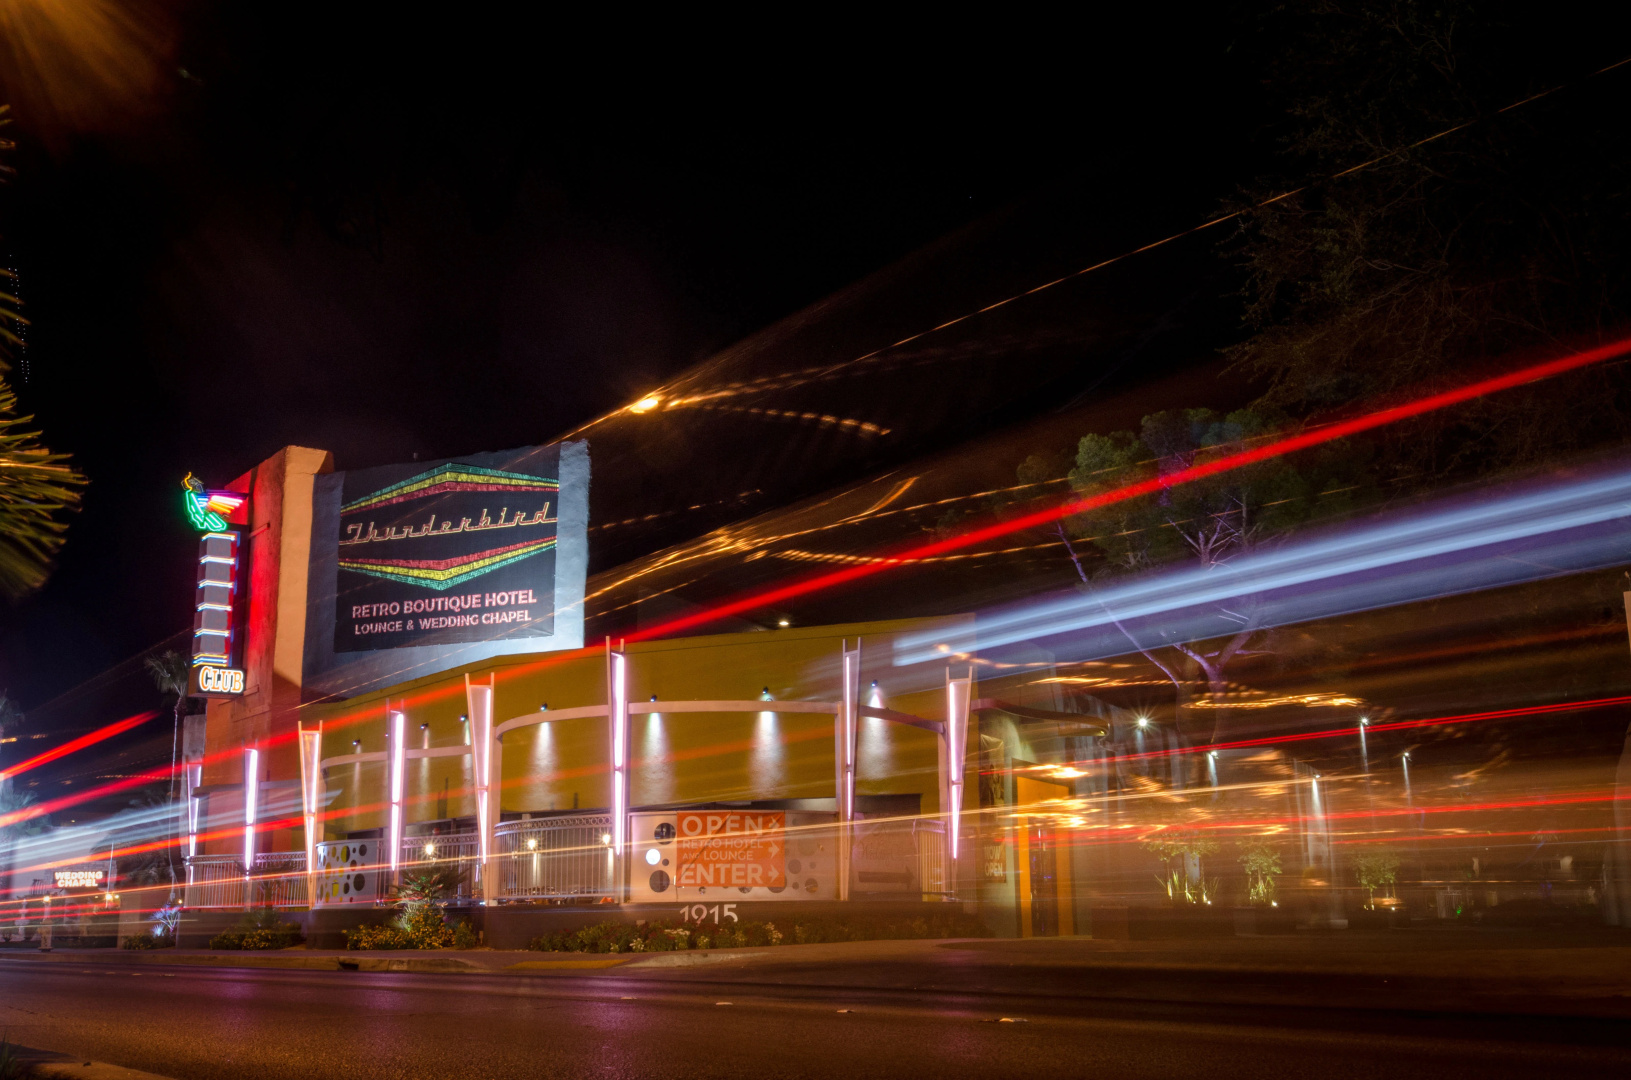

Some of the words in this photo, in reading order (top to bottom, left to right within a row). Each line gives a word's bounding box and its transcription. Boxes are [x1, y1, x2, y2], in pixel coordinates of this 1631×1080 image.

[339, 502, 558, 545] Thunderbird
[352, 601, 400, 619] RETRO
[403, 593, 482, 614] BOUTIQUE
[485, 589, 537, 607] HOTEL
[355, 620, 402, 635] LOUNGE
[406, 619, 414, 631] &
[419, 614, 479, 630] WEDDING
[482, 610, 531, 625] CHAPEL
[199, 666, 244, 693] CLUB
[682, 815, 763, 836] OPEN
[682, 838, 721, 849] RETRO
[725, 838, 763, 849] HOTEL
[703, 850, 754, 861] LOUNGE
[55, 871, 103, 880] WEDDING
[680, 863, 763, 884] ENTER
[984, 862, 1003, 877] OPEN
[57, 878, 98, 887] CHAPEL
[680, 903, 738, 925] 1915
